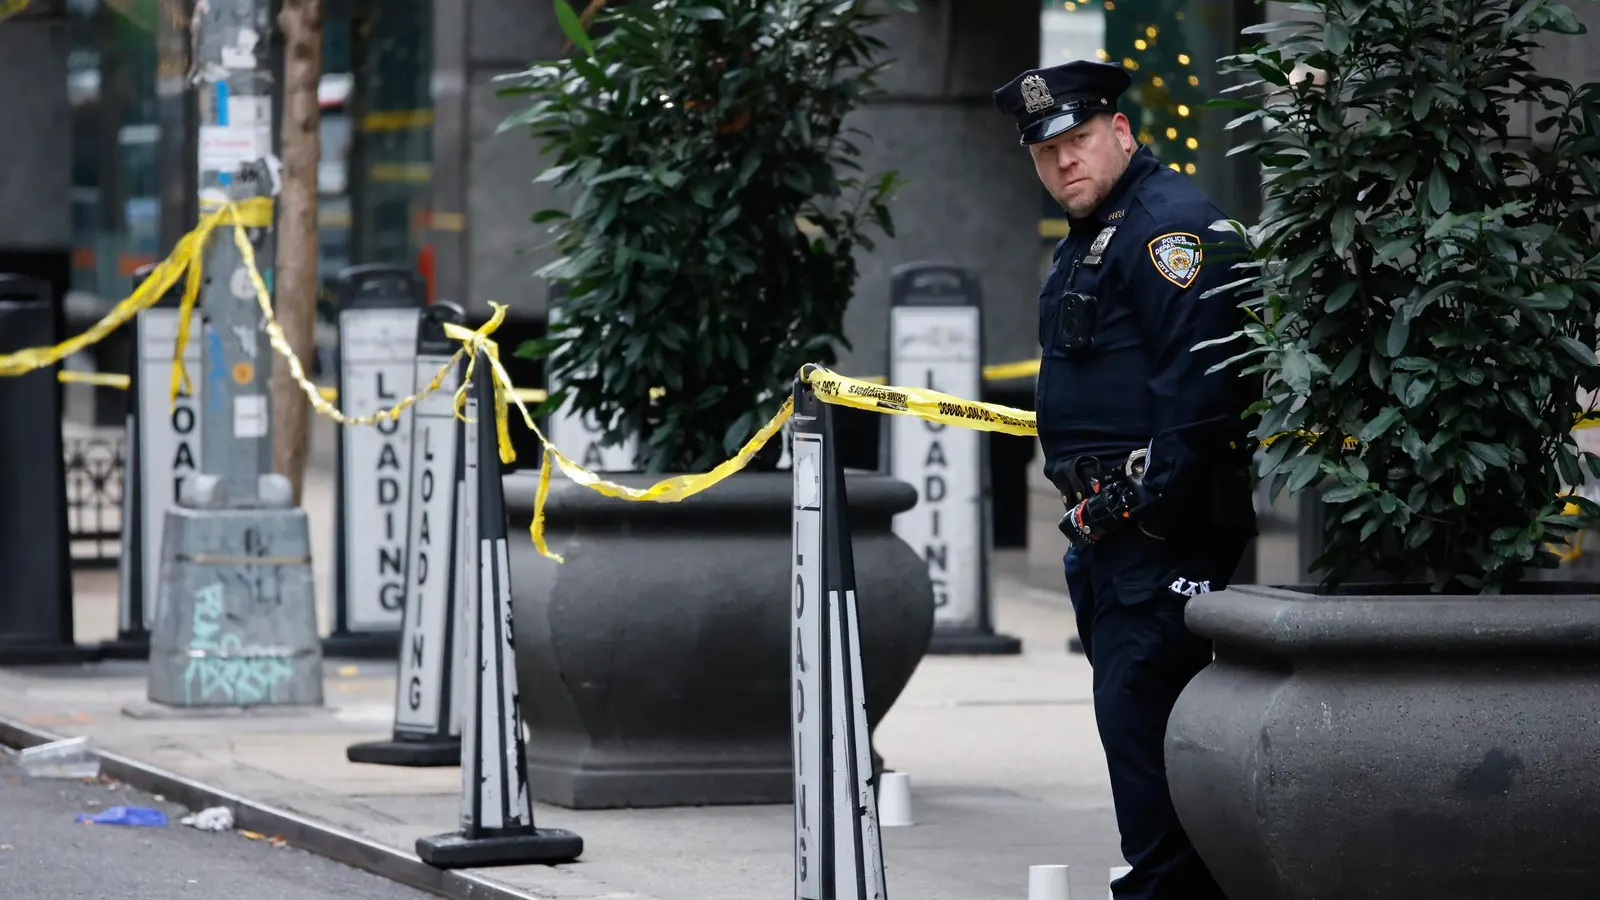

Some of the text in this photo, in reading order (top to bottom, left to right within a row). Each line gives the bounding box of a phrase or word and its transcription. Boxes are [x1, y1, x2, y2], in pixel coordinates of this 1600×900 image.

[1158, 261, 1169, 273] CITY
[1162, 236, 1187, 245] POLICE
[376, 371, 405, 614] LOADING
[408, 427, 435, 711] LOADING
[793, 522, 808, 883] LOADING
